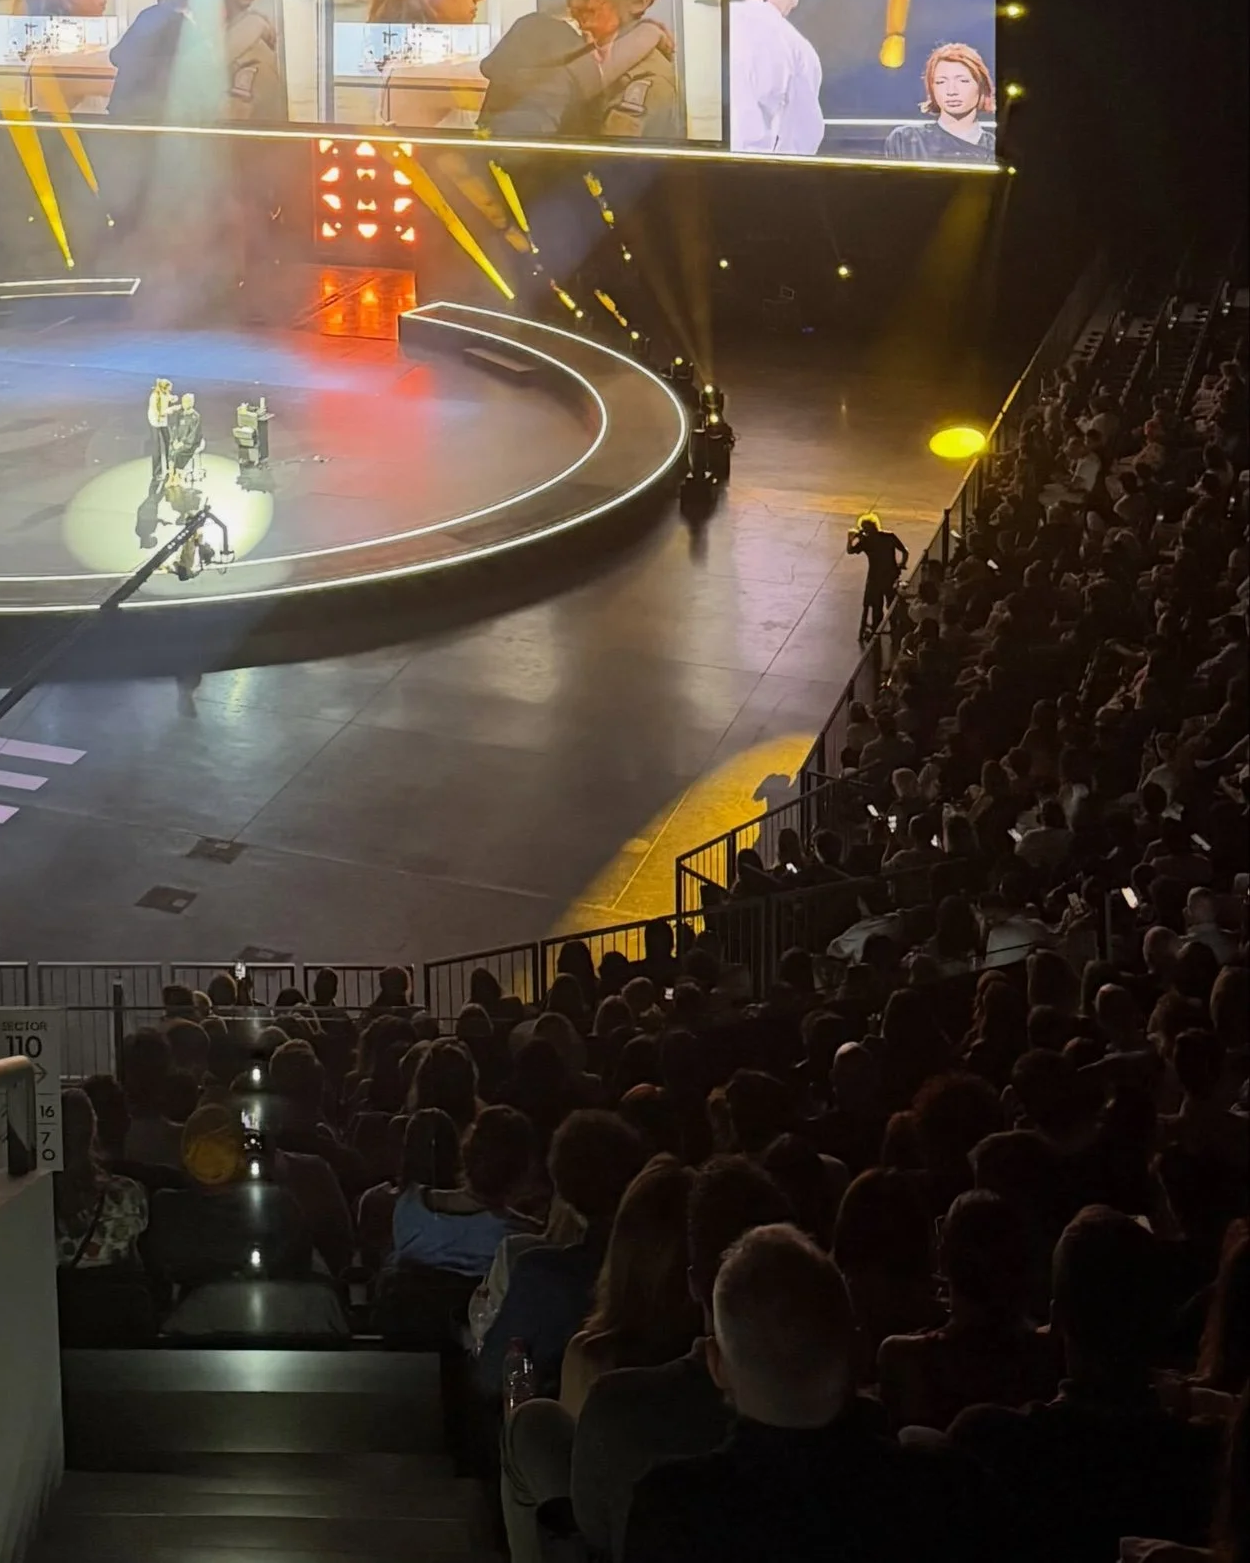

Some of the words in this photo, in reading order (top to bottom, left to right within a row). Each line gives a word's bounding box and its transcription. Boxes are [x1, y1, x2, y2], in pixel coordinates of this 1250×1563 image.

[1, 1021, 48, 1031] SECTOR
[6, 1035, 43, 1058] 110
[40, 1105, 55, 1118] 16
[40, 1132, 51, 1144] 7
